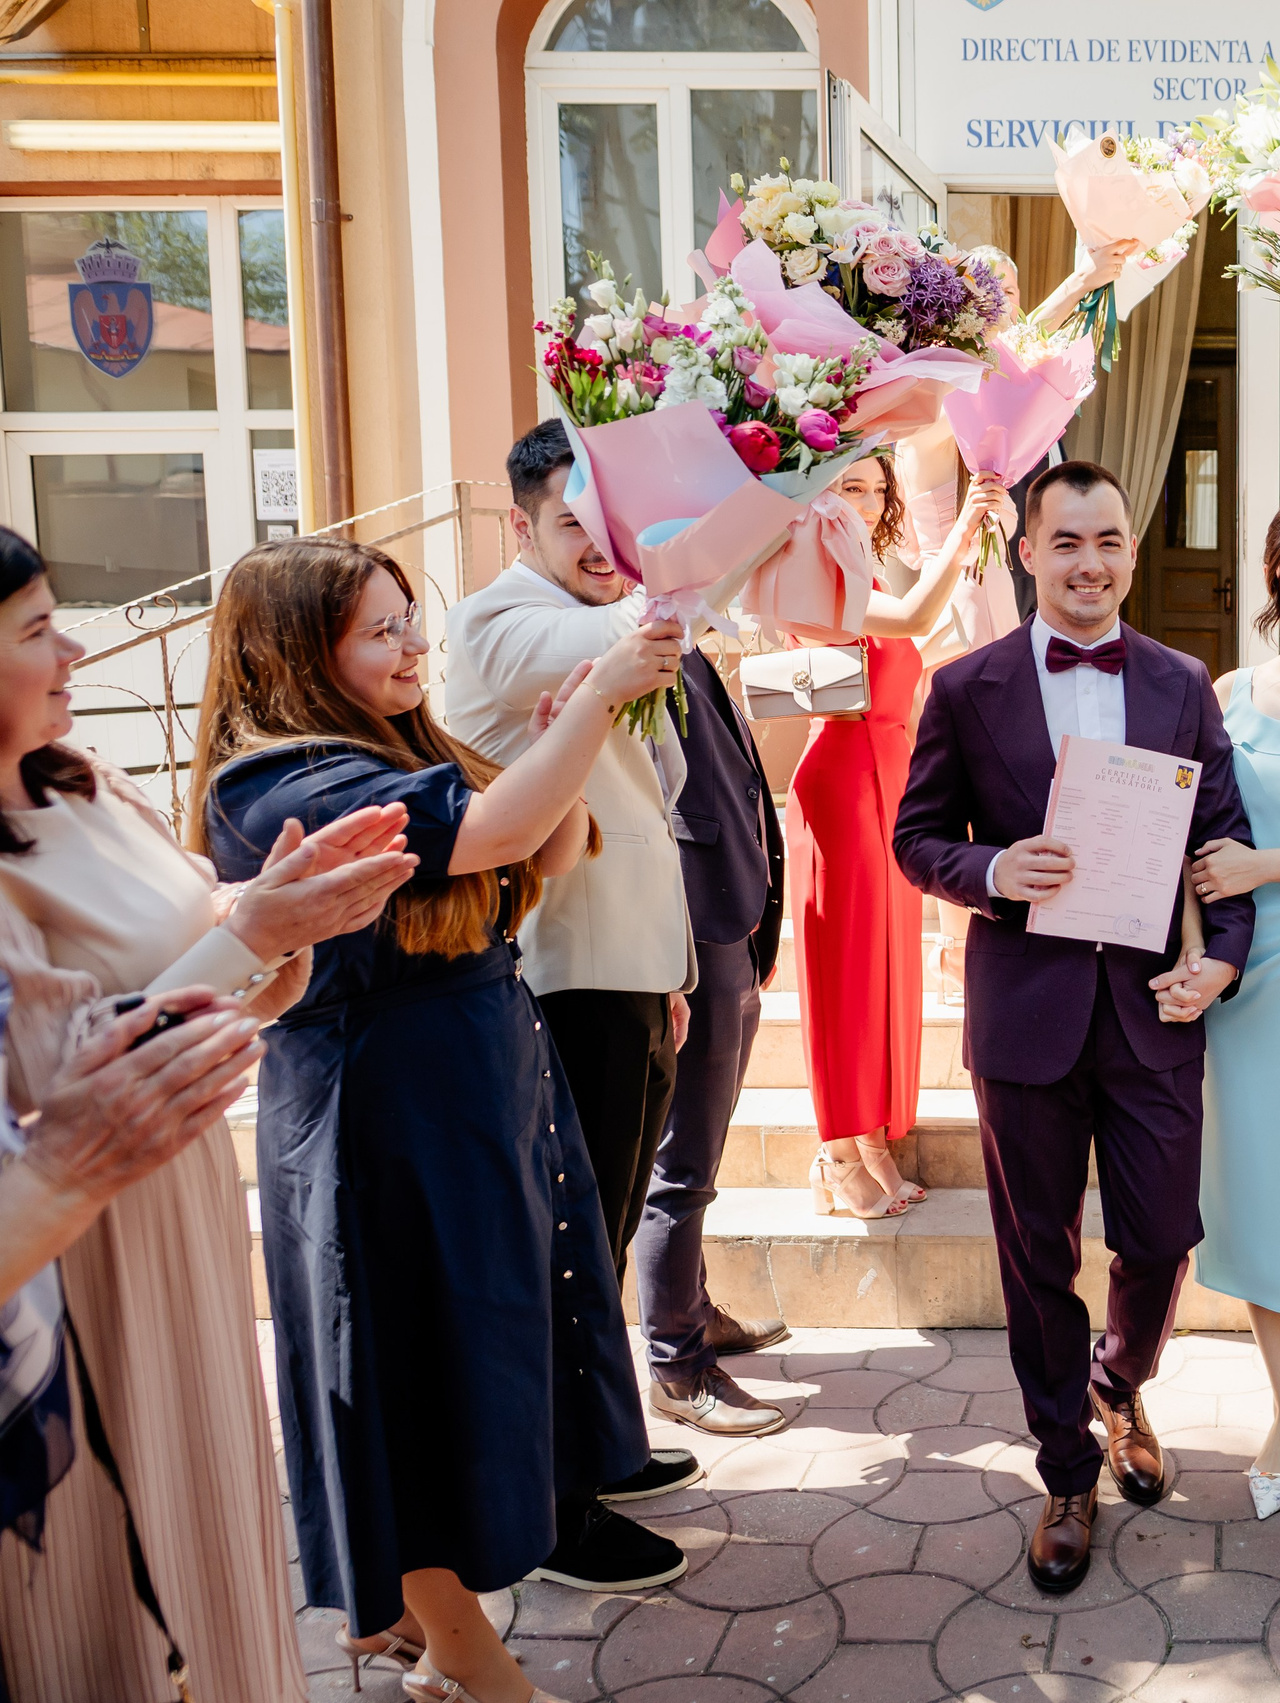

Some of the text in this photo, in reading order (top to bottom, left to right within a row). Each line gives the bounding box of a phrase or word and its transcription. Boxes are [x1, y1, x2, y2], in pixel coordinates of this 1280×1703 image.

[961, 38, 1080, 62] DIRECTIA
[1087, 39, 1121, 62] DE
[1127, 39, 1252, 63] EVIDENTA
[1259, 41, 1277, 63] A
[1153, 77, 1248, 101] SECTOR
[1101, 768, 1160, 786] CERTIFICAT
